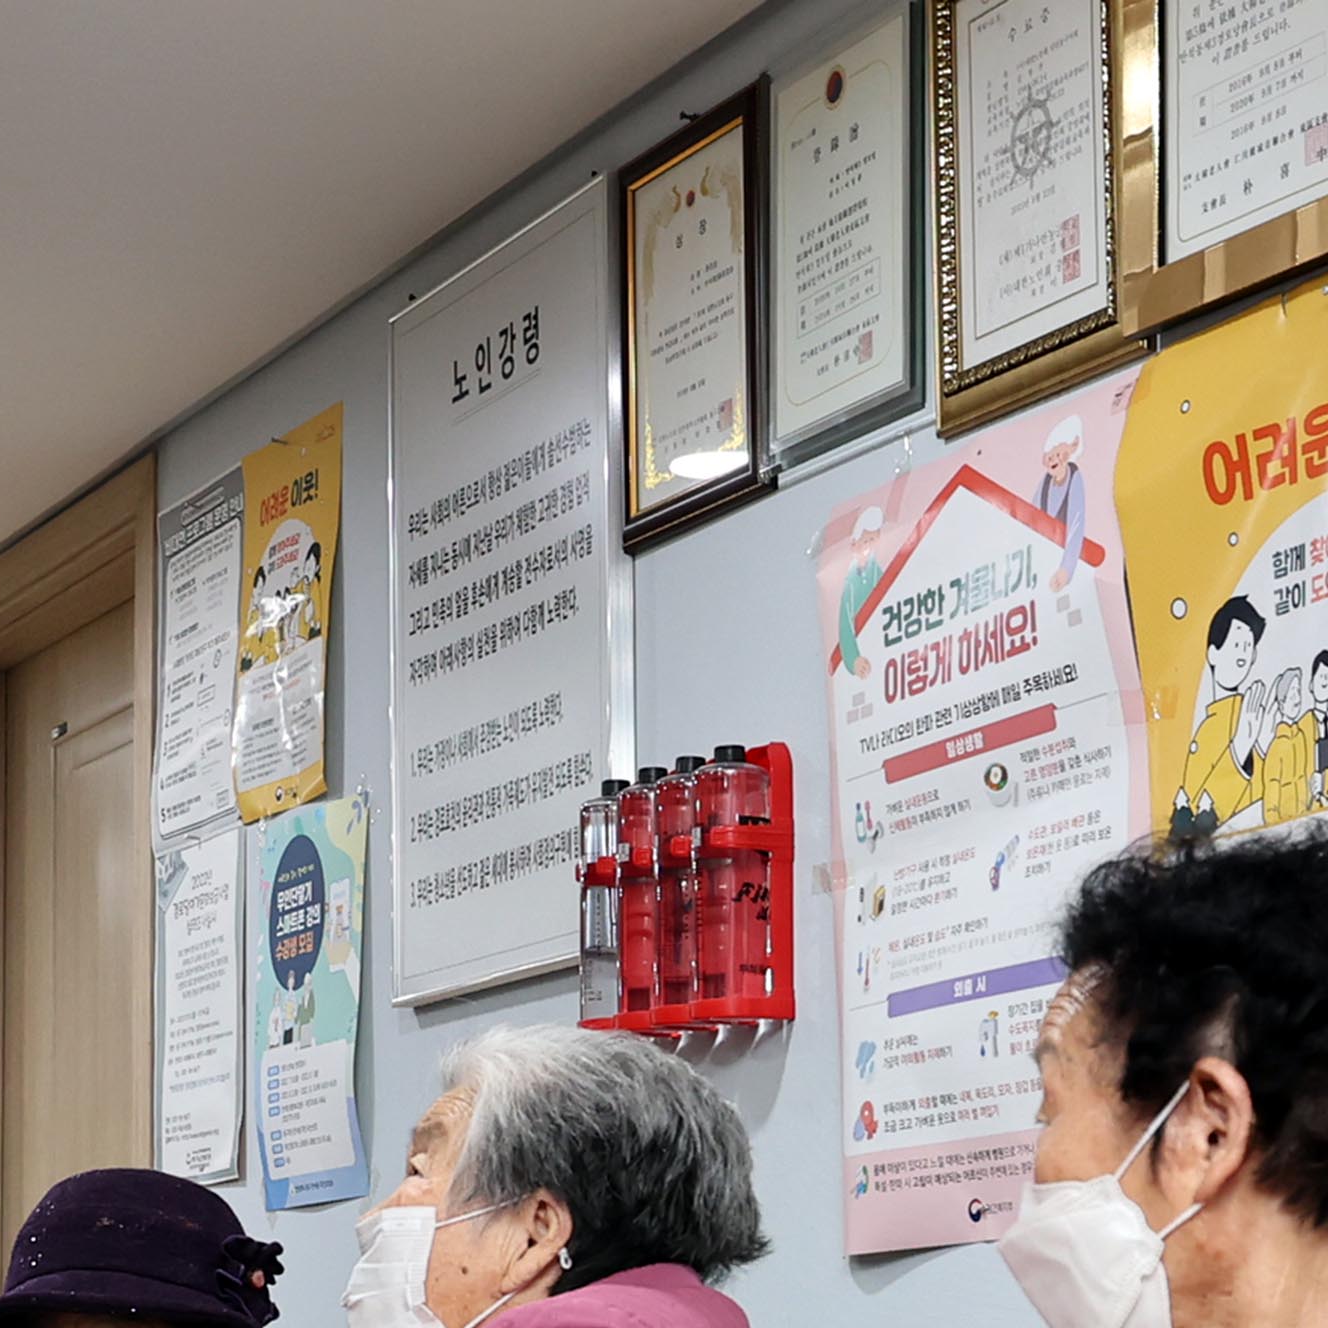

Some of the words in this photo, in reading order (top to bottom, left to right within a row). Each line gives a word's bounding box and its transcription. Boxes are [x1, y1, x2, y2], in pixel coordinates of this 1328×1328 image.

[452, 305, 540, 404] 노인강령
[291, 468, 319, 507] 이웃!
[408, 504, 428, 542] 우리는
[452, 473, 486, 520] 어른으로서
[494, 511, 513, 549] 우리가
[1272, 544, 1306, 580] 함께
[409, 604, 430, 639] 그리고
[471, 570, 499, 611] 후손에게
[882, 583, 945, 648] 건강한
[950, 544, 1038, 621] 겨울나기,
[1273, 584, 1307, 615] 같이
[884, 636, 952, 705] 이렇게
[958, 600, 1039, 676] 하세요!
[878, 721, 914, 750] 라디오의
[934, 706, 952, 731] 관련
[1023, 663, 1079, 696] 주목하세요!
[945, 730, 984, 760] 일상생활
[277, 880, 312, 912] 무인단말기
[276, 909, 304, 936] 스마트폰
[306, 903, 320, 927] 강의
[275, 936, 297, 961] 수강생
[298, 931, 314, 954] 모집
[953, 980, 973, 1000] 외출
[975, 975, 987, 993] 시
